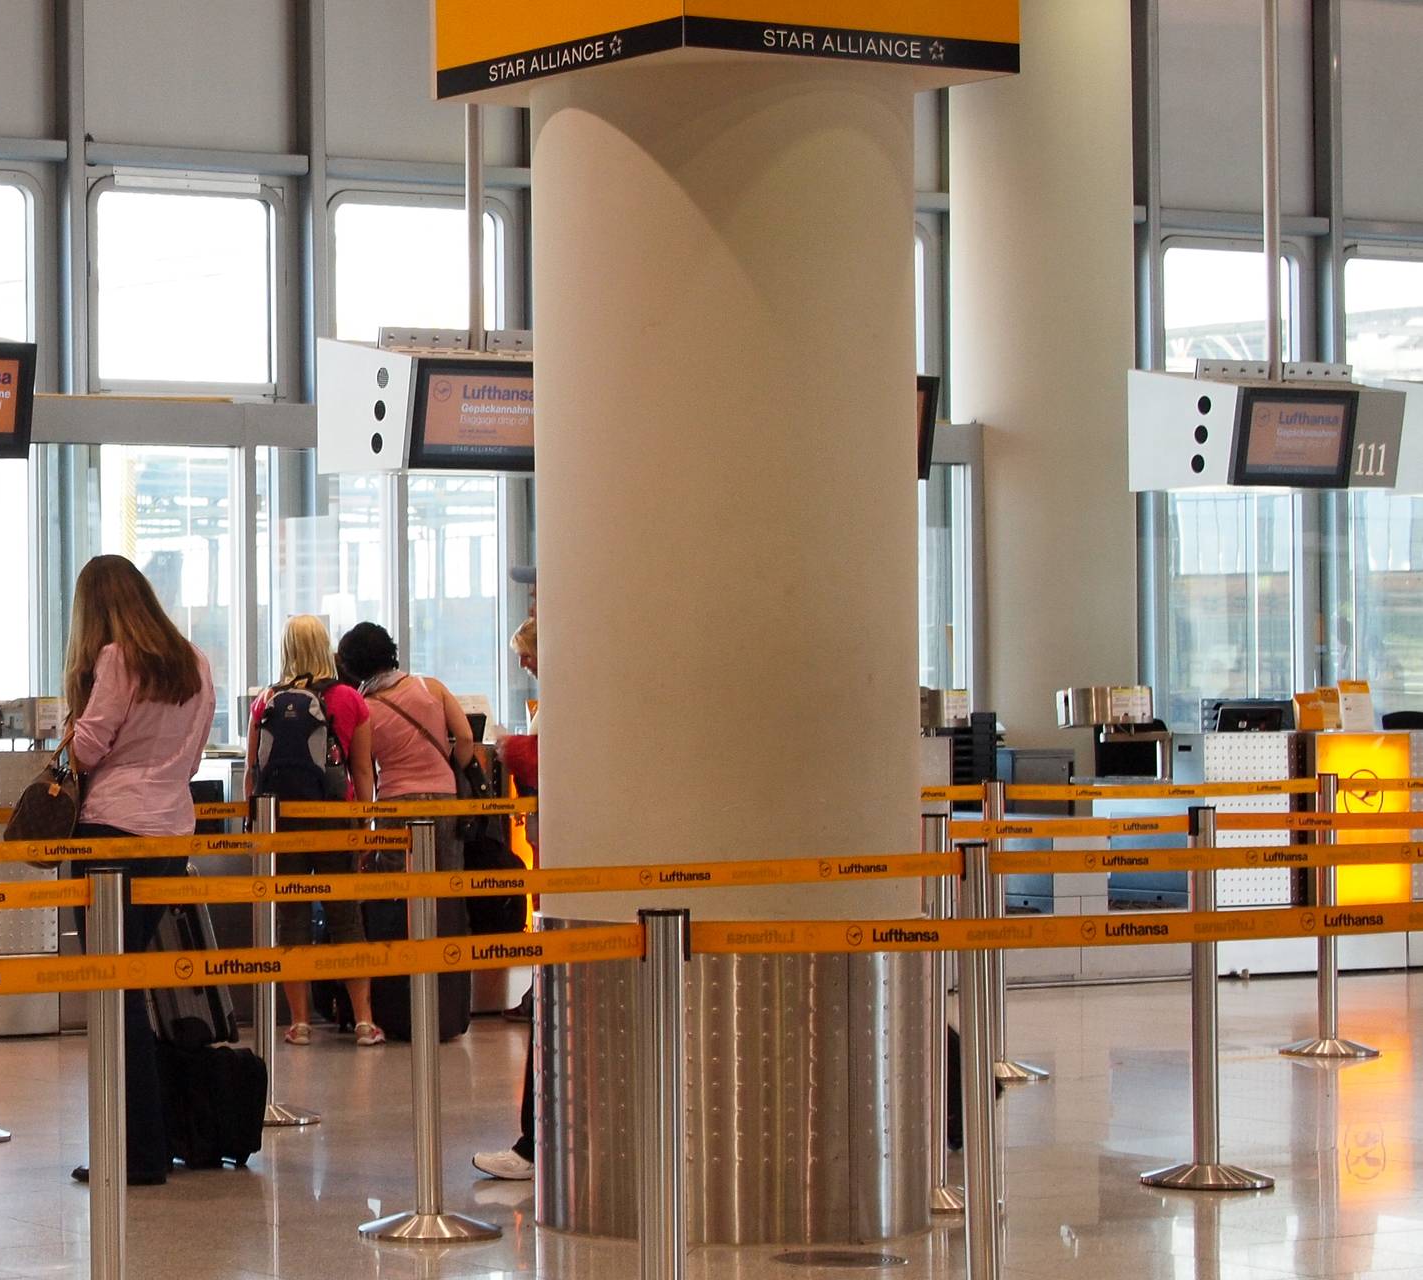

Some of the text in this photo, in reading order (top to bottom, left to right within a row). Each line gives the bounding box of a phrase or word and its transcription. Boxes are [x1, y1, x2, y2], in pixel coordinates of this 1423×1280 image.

[762, 29, 922, 60] STAR ALLIANCE
[488, 41, 604, 82] STAR ALLIANCE
[461, 403, 533, 415] Gepäckannahm
[1279, 410, 1339, 425] Lufthansa
[1355, 443, 1385, 476] 111
[200, 807, 235, 815] Lufthansa
[1298, 817, 1332, 826] Lufthansa
[995, 825, 1032, 835] Lufthansa
[1123, 823, 1159, 832] Lufthansa
[207, 840, 252, 849] Lufthansa
[364, 835, 408, 845] Lufthansa
[44, 845, 92, 856] Lufthansa
[1102, 855, 1149, 866] Lufthansa
[1263, 851, 1308, 862] Lufthansa
[838, 862, 887, 873] Lufthansa
[659, 870, 711, 882] Lufthansa
[274, 883, 331, 894] Lufthansa
[471, 878, 524, 889] Lufthansa
[1323, 914, 1384, 928] Lufthansa
[872, 928, 939, 942] Lufthansa
[1104, 923, 1168, 937] Lufthansa
[471, 943, 543, 960] Lufthansa
[204, 958, 281, 976] Lufthansa
